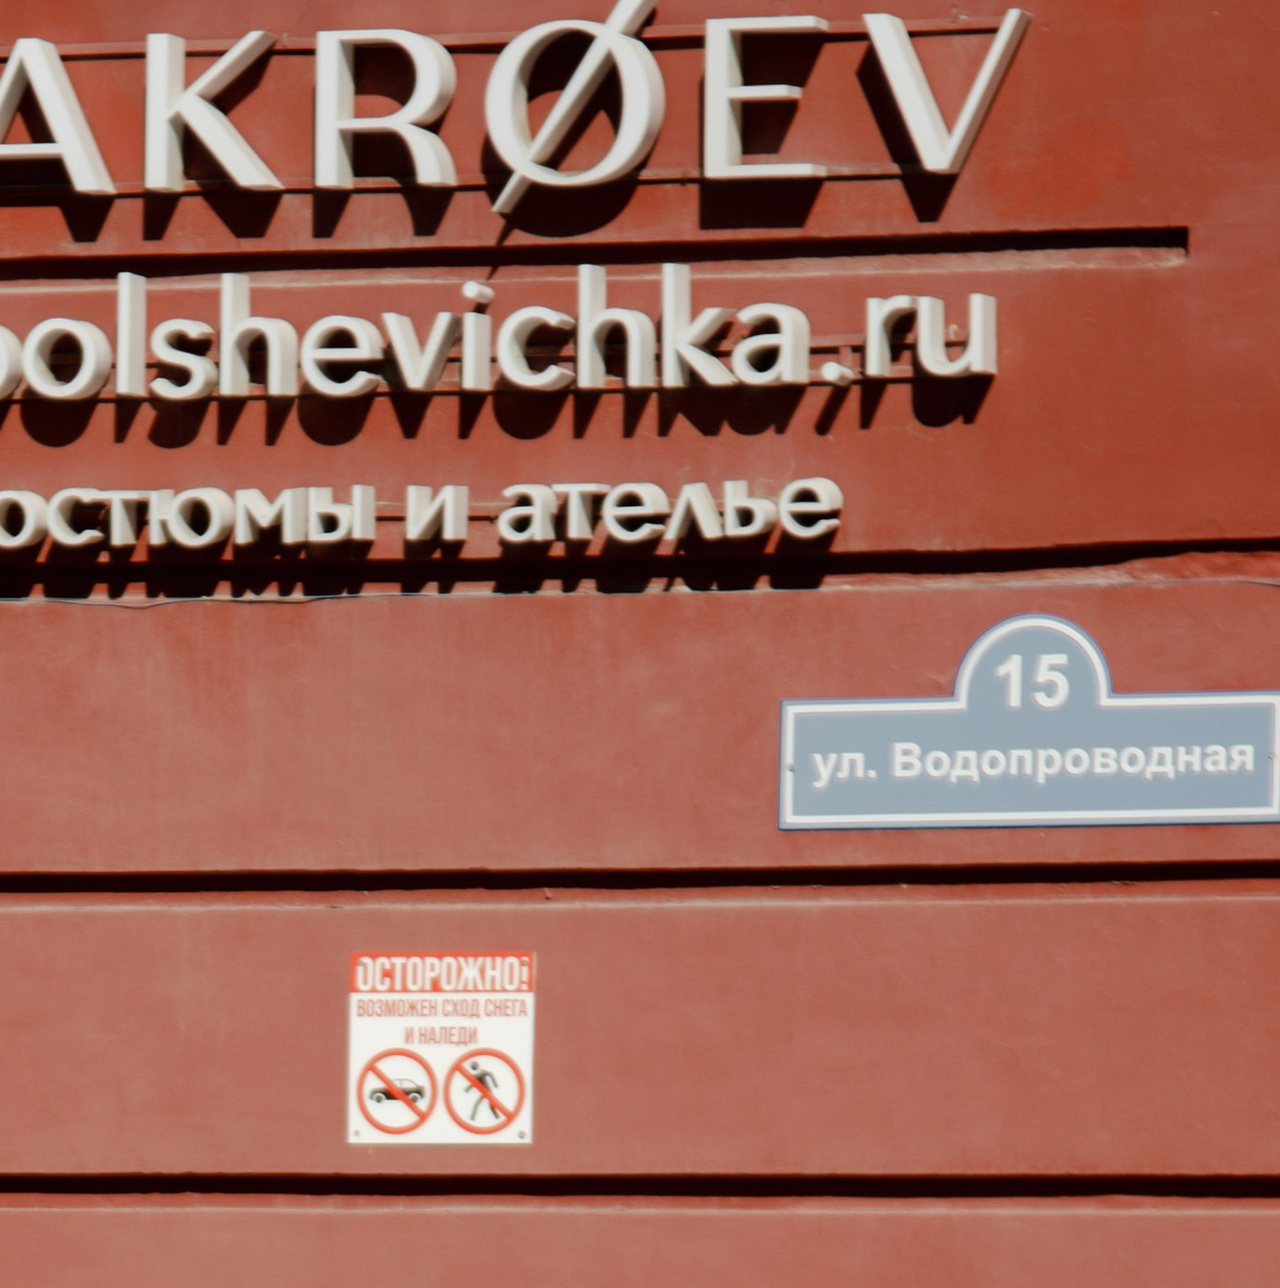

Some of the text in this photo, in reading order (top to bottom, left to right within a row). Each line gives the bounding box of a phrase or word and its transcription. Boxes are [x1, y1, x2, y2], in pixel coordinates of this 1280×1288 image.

[406, 484, 469, 541] и
[497, 477, 845, 543] ателье
[995, 653, 1070, 708] 15
[812, 741, 1255, 789] ул. Водопроводная
[356, 956, 530, 991] ОСТОРОЖНО!
[356, 998, 528, 1019] ВОЗМОЖЕН СХОД СНЕГА
[404, 1026, 478, 1046] И НАЛЕДИ
